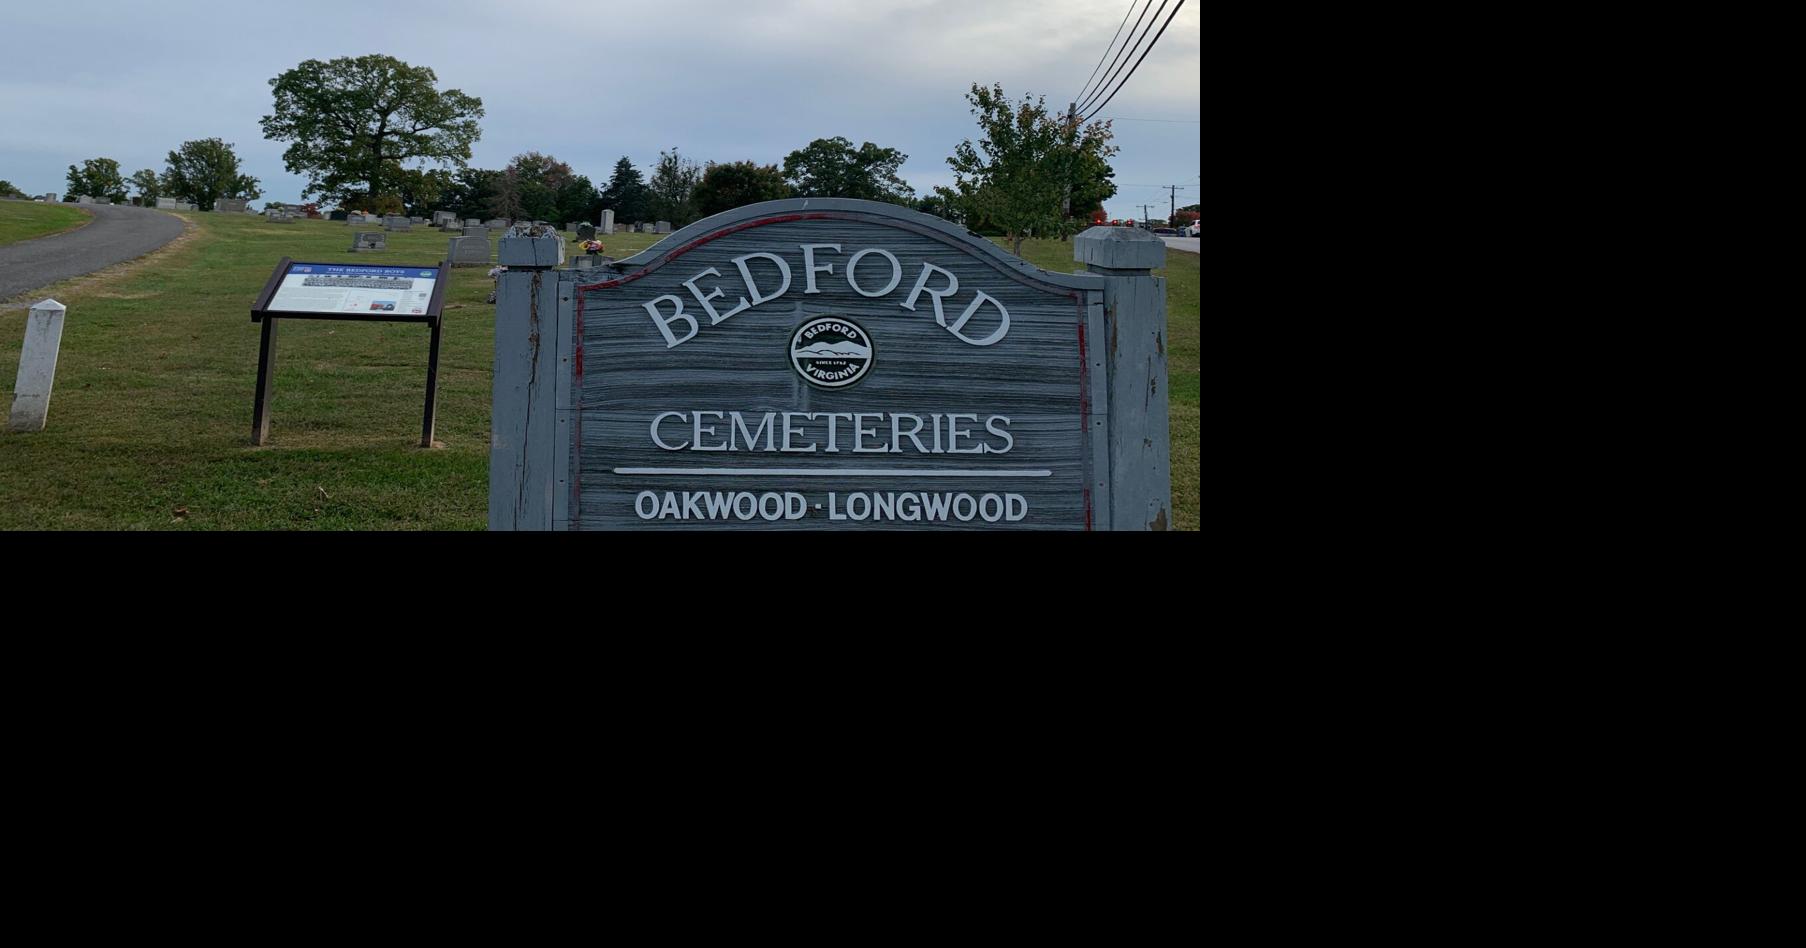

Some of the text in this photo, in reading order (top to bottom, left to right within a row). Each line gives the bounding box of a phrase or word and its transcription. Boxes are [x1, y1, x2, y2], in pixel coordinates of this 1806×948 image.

[642, 243, 1011, 348] BEDFORD
[804, 323, 857, 339] BEDFORD
[806, 363, 860, 380] VIRGINIA
[650, 411, 1014, 454] CEMETERIES
[634, 491, 1029, 521] OAKWOOD LONGWOOD
